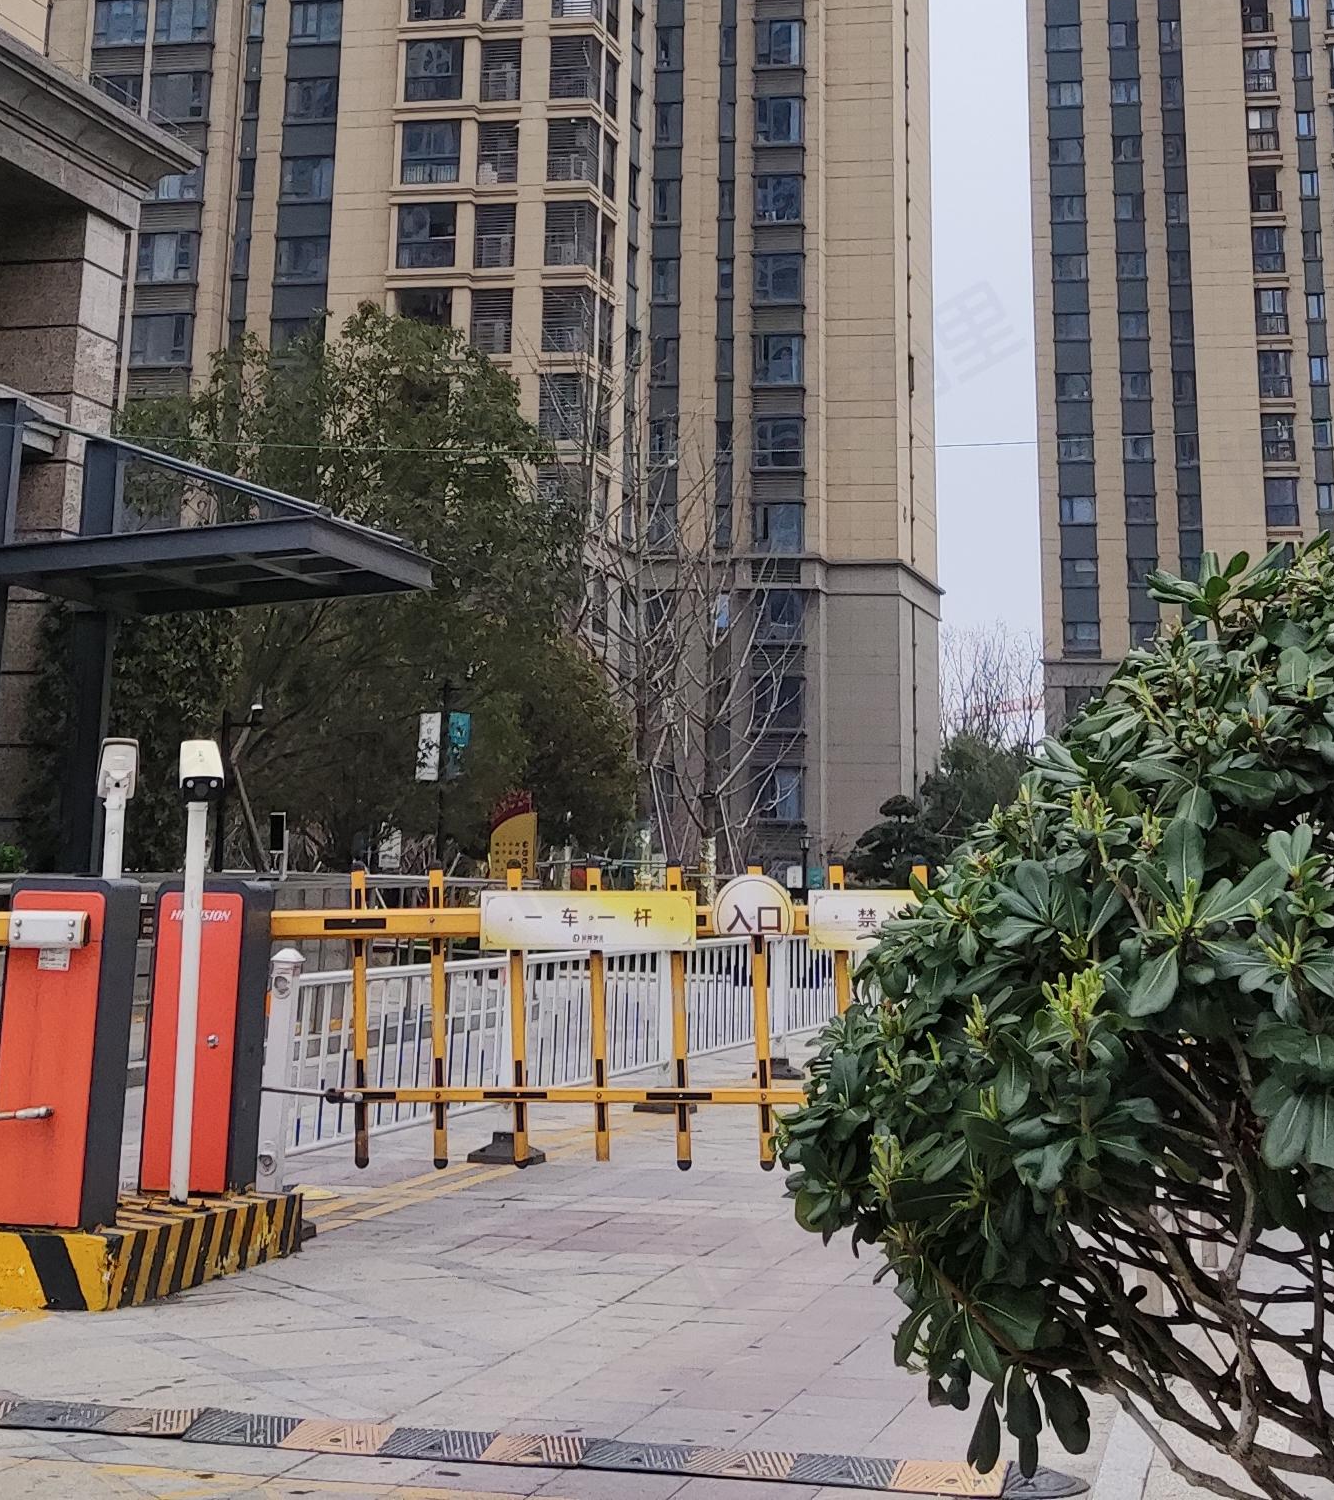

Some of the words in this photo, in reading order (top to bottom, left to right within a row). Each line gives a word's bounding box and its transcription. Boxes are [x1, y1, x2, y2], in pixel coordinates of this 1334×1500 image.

[170, 909, 231, 922] HIISION
[524, 907, 653, 928] 一车一杆
[727, 903, 782, 933] 入口
